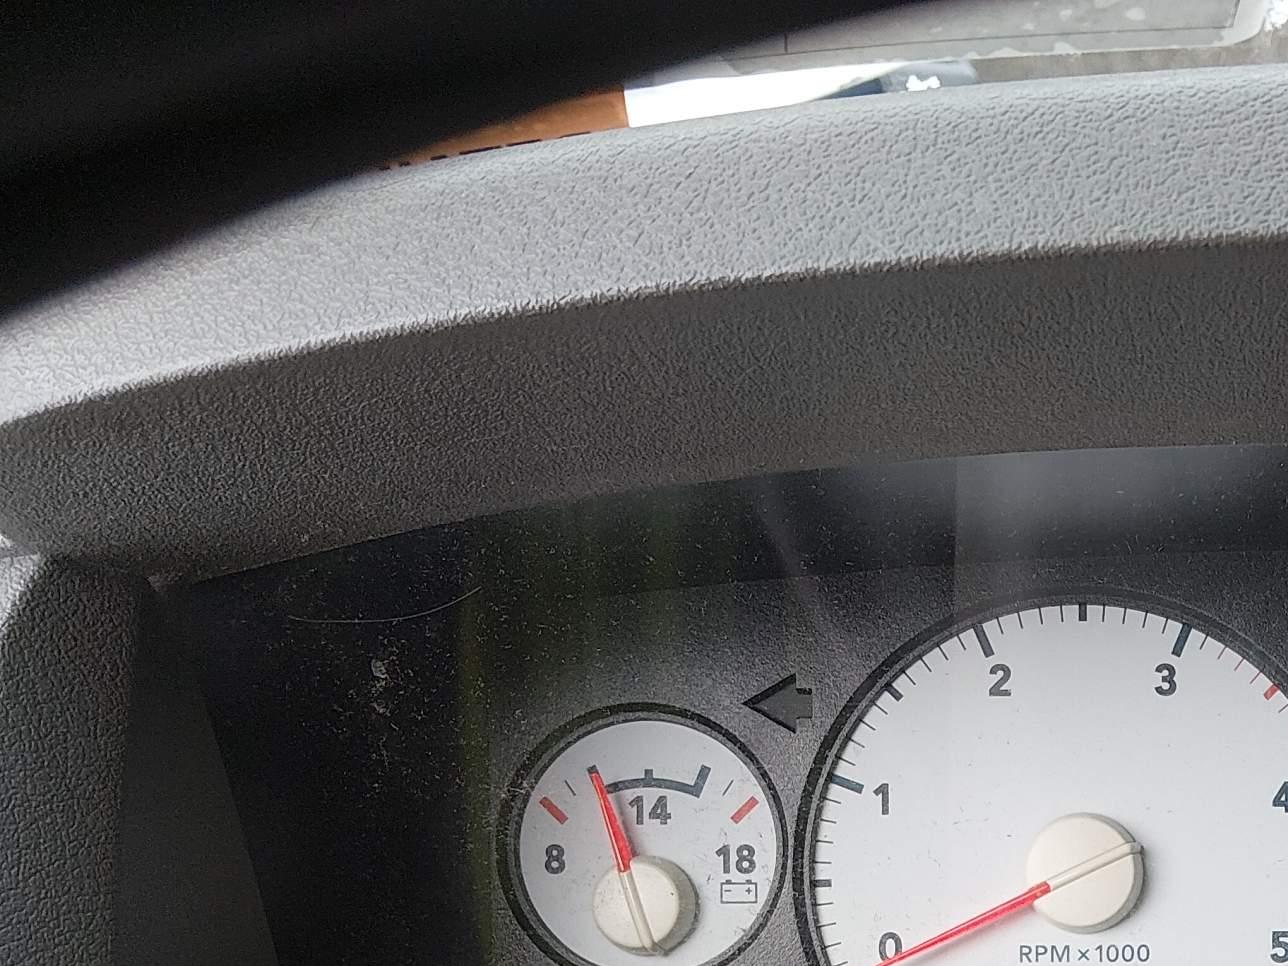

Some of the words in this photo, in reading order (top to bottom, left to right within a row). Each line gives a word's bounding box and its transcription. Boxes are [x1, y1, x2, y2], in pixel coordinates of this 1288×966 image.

[988, 663, 1012, 697] 2
[1154, 662, 1177, 697] 3
[628, 795, 672, 826] 14
[872, 782, 890, 816] 1
[544, 843, 566, 875] 8
[715, 843, 757, 875] 18
[878, 931, 903, 962] 0
[1019, 944, 1071, 963] RPM
